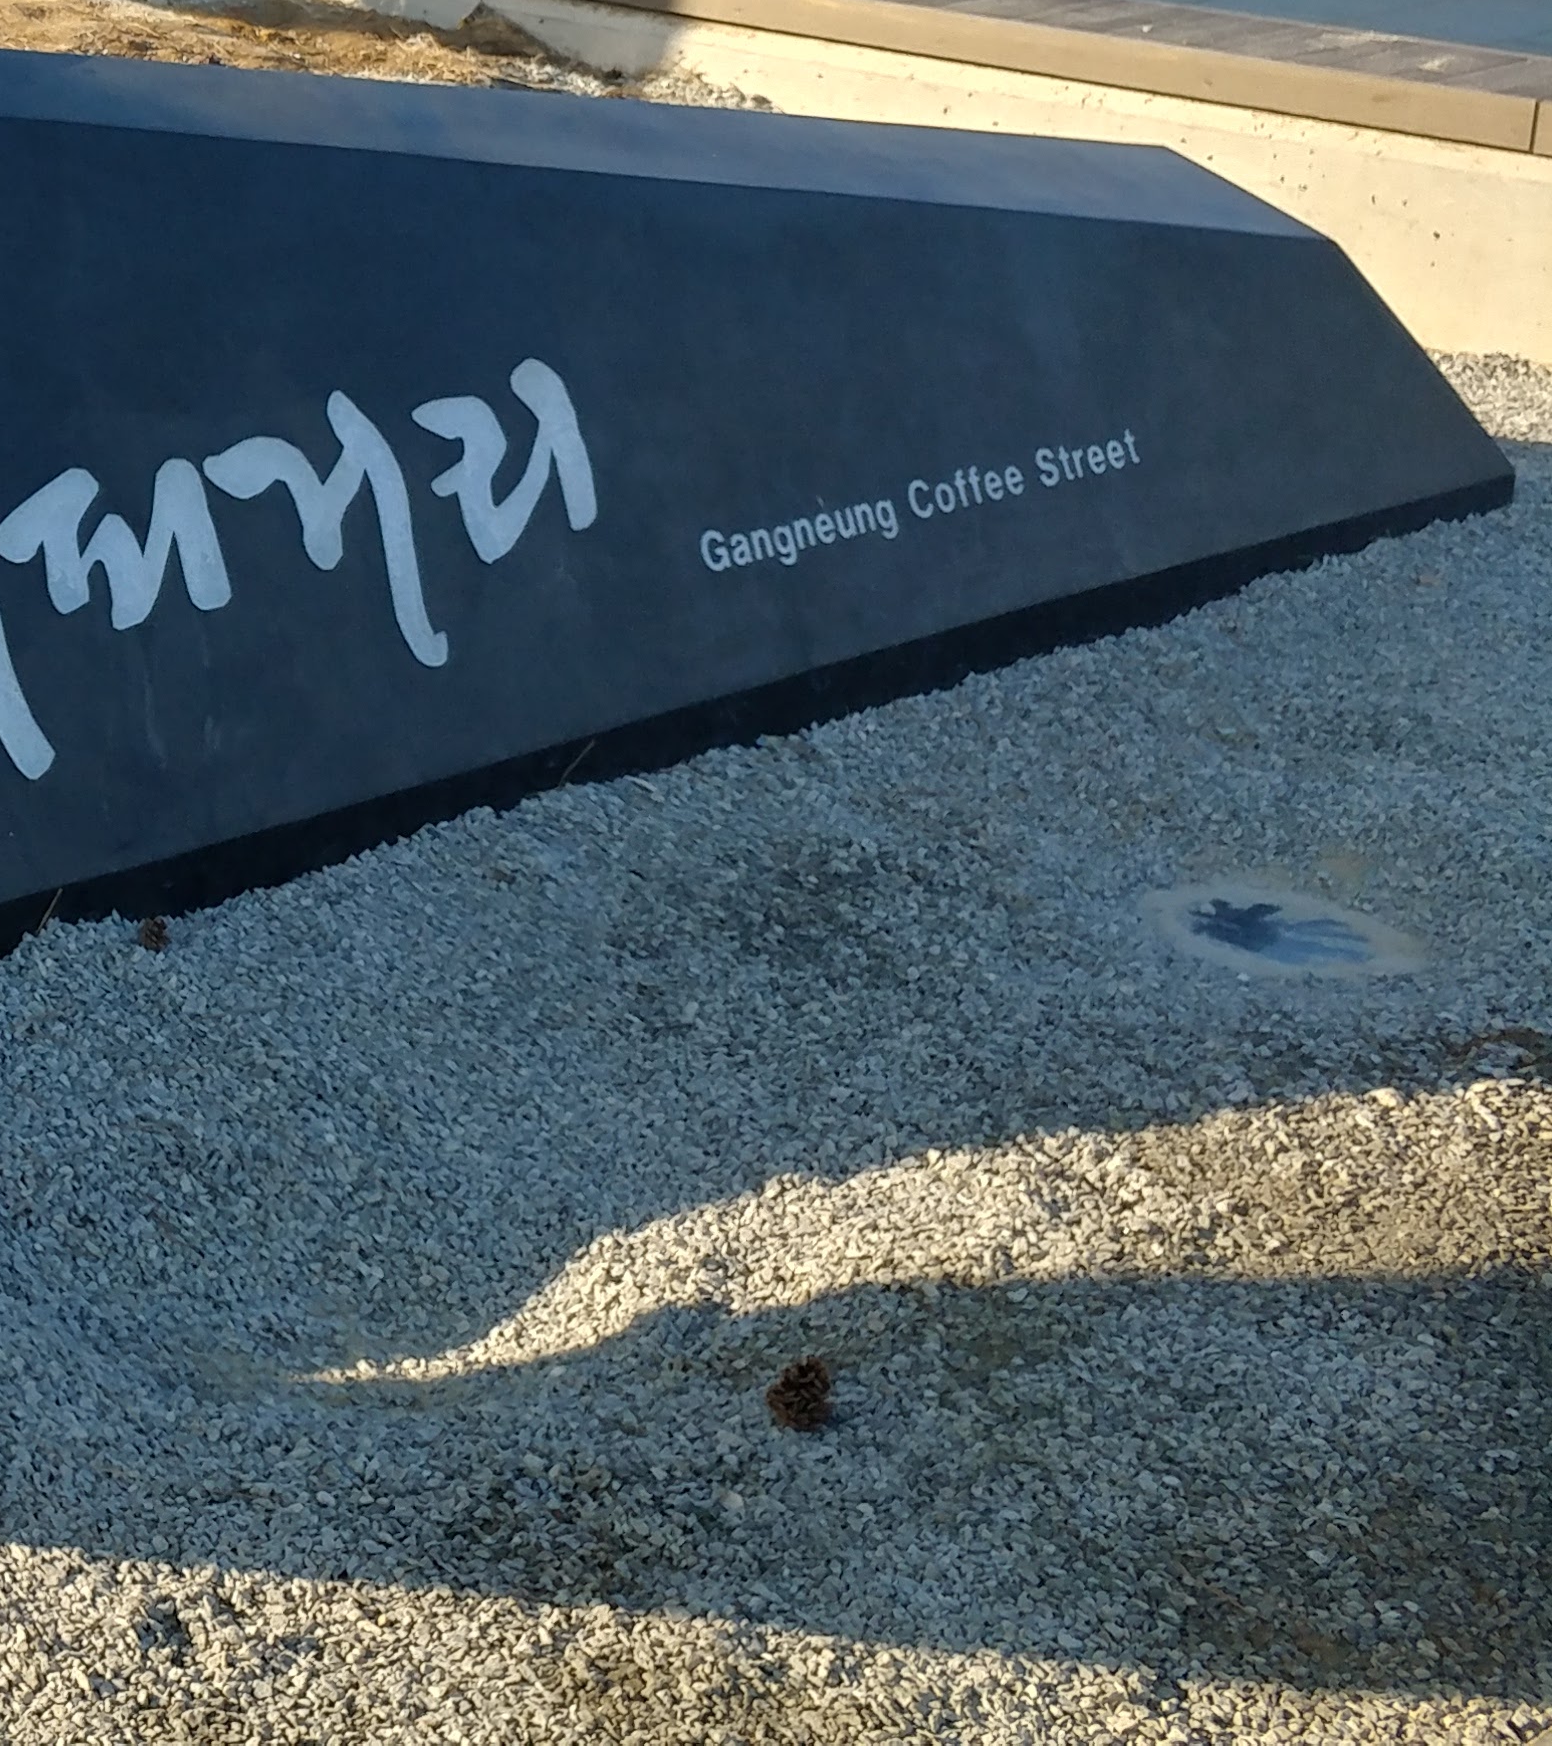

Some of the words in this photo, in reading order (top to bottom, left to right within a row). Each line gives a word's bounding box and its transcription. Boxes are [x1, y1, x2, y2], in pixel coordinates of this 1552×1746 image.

[700, 499, 900, 572] Gangneung
[907, 465, 1025, 520] Coffee
[1034, 428, 1141, 487] Street
